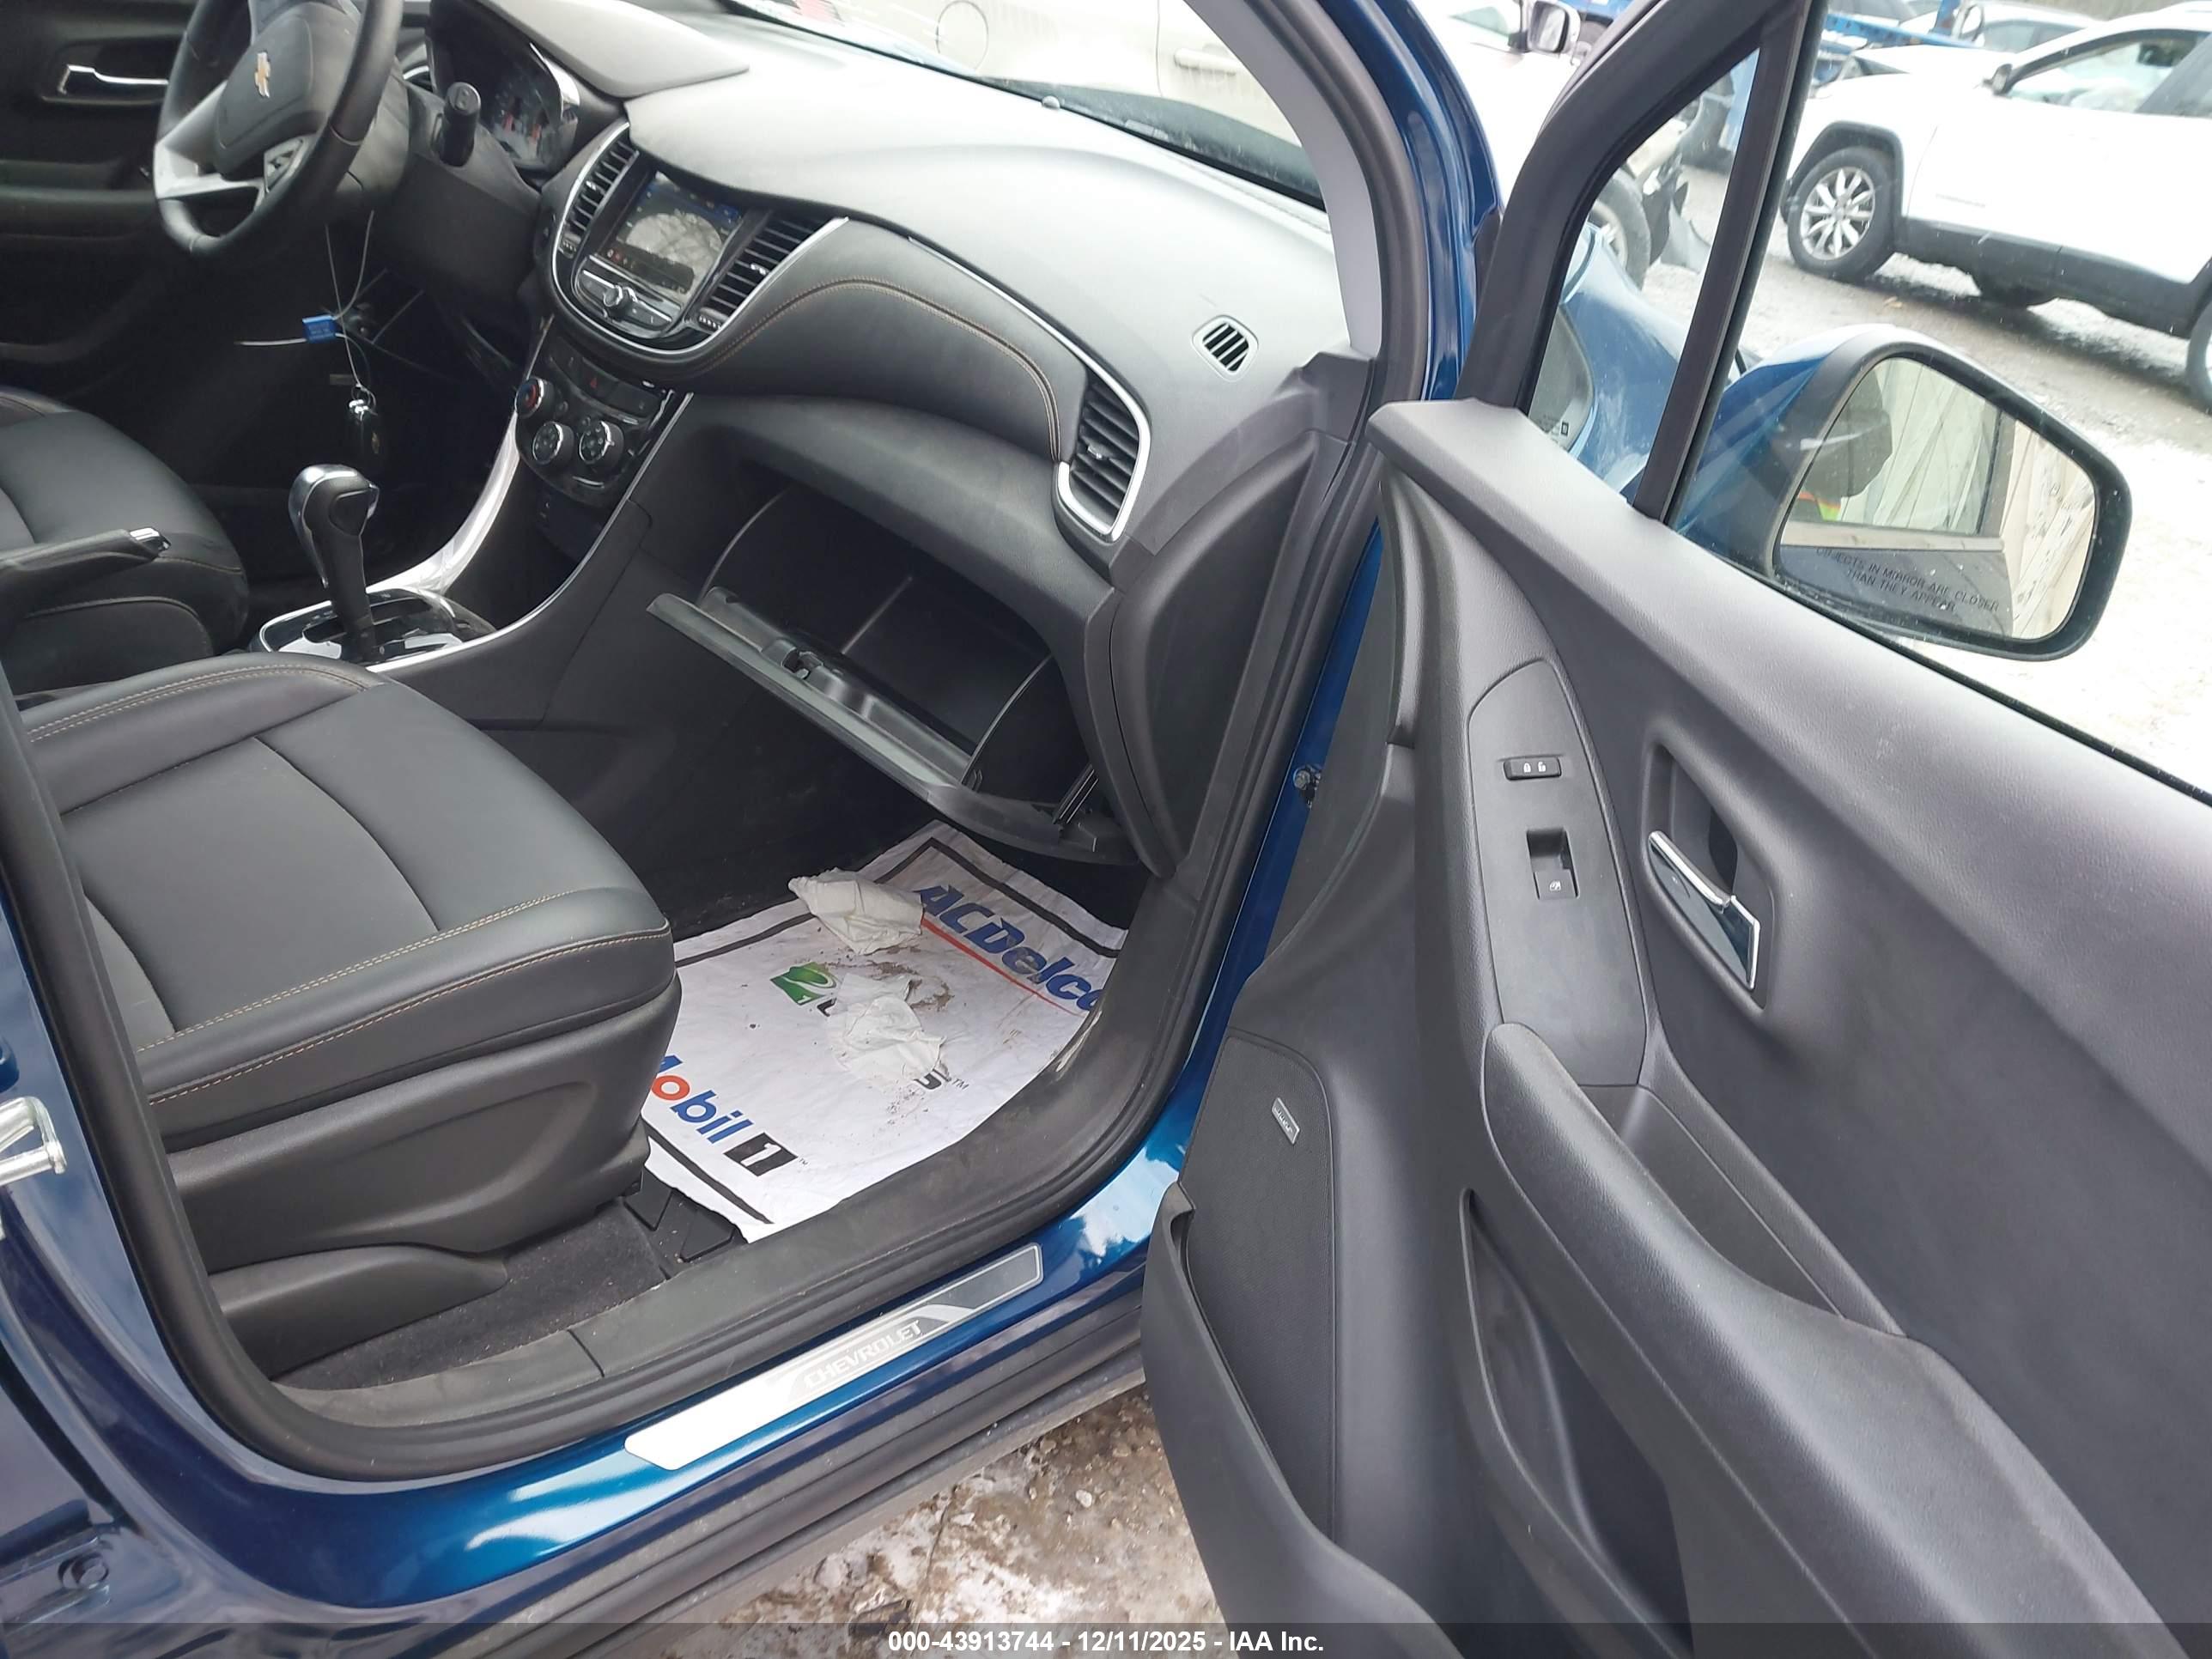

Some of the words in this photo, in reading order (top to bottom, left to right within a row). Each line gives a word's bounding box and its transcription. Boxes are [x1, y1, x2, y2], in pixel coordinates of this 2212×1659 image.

[1847, 569, 1876, 586] THAN
[1880, 580, 1908, 595] THEY
[1911, 590, 1956, 612] APPEAR
[1869, 563, 1881, 574] IN
[1883, 568, 1925, 589] MIRROR
[1954, 591, 2000, 611] CLOSER
[804, 1320, 921, 1388] CHEVROLET
